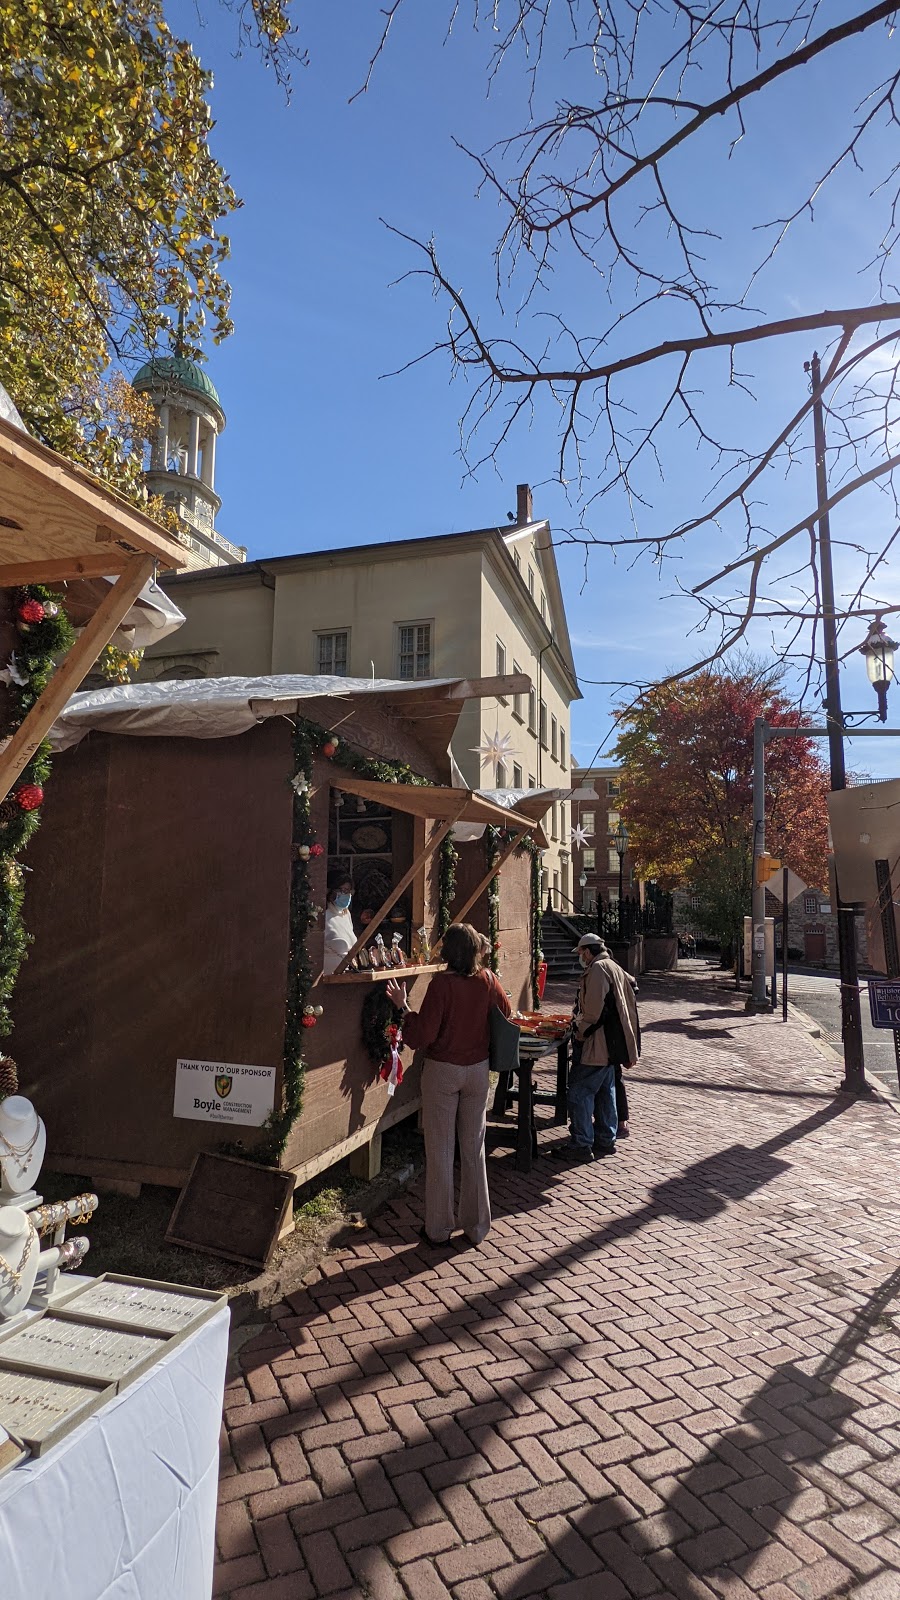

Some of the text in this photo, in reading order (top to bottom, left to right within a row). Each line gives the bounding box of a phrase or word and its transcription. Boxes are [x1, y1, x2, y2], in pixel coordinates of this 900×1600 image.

[180, 1062, 199, 1070] THANK
[200, 1064, 214, 1072] YOU
[241, 1068, 272, 1077] SPONSOR
[193, 1098, 221, 1112] Boyle
